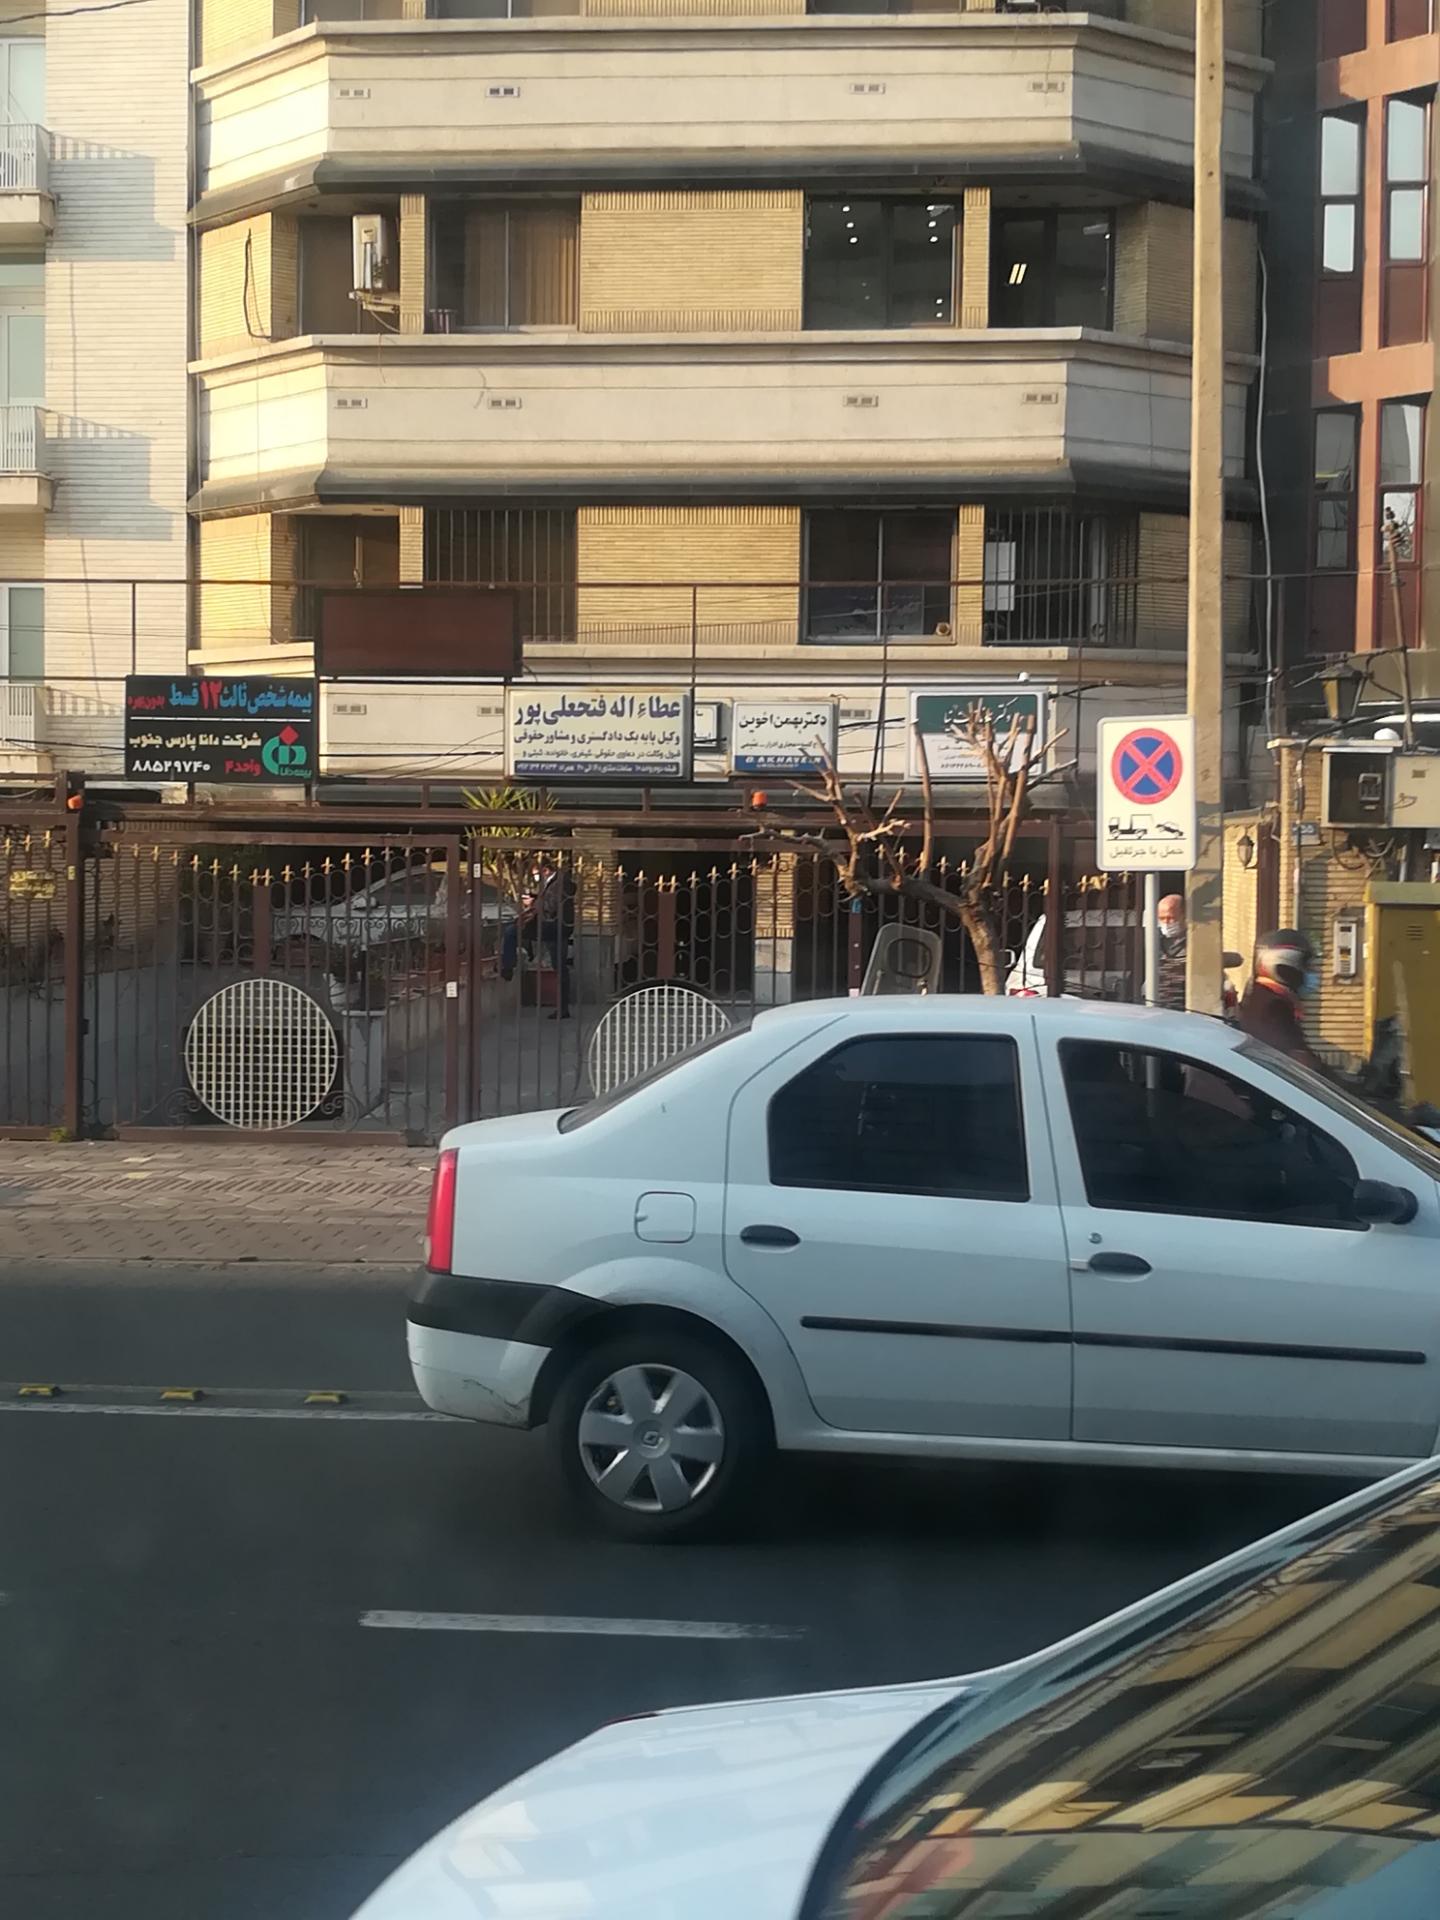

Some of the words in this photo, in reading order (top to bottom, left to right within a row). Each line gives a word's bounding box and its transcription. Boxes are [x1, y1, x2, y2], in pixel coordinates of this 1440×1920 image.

[169, 682, 199, 706] قسط
[220, 682, 247, 708] ثالث
[247, 684, 287, 714] شخص
[287, 690, 312, 713] بیمه
[514, 703, 541, 725] پور
[739, 711, 774, 732] اخوین
[802, 711, 827, 729] دکتر
[774, 715, 803, 733] بهمن
[129, 732, 163, 749] جنوب
[165, 733, 197, 752] پارس
[198, 733, 220, 746] دانا
[222, 732, 262, 750] شرکت
[514, 728, 545, 744] حقوقی
[544, 730, 570, 744] مشاور
[624, 730, 640, 745] یک
[640, 730, 656, 746] پایه
[657, 730, 680, 745] وکیل
